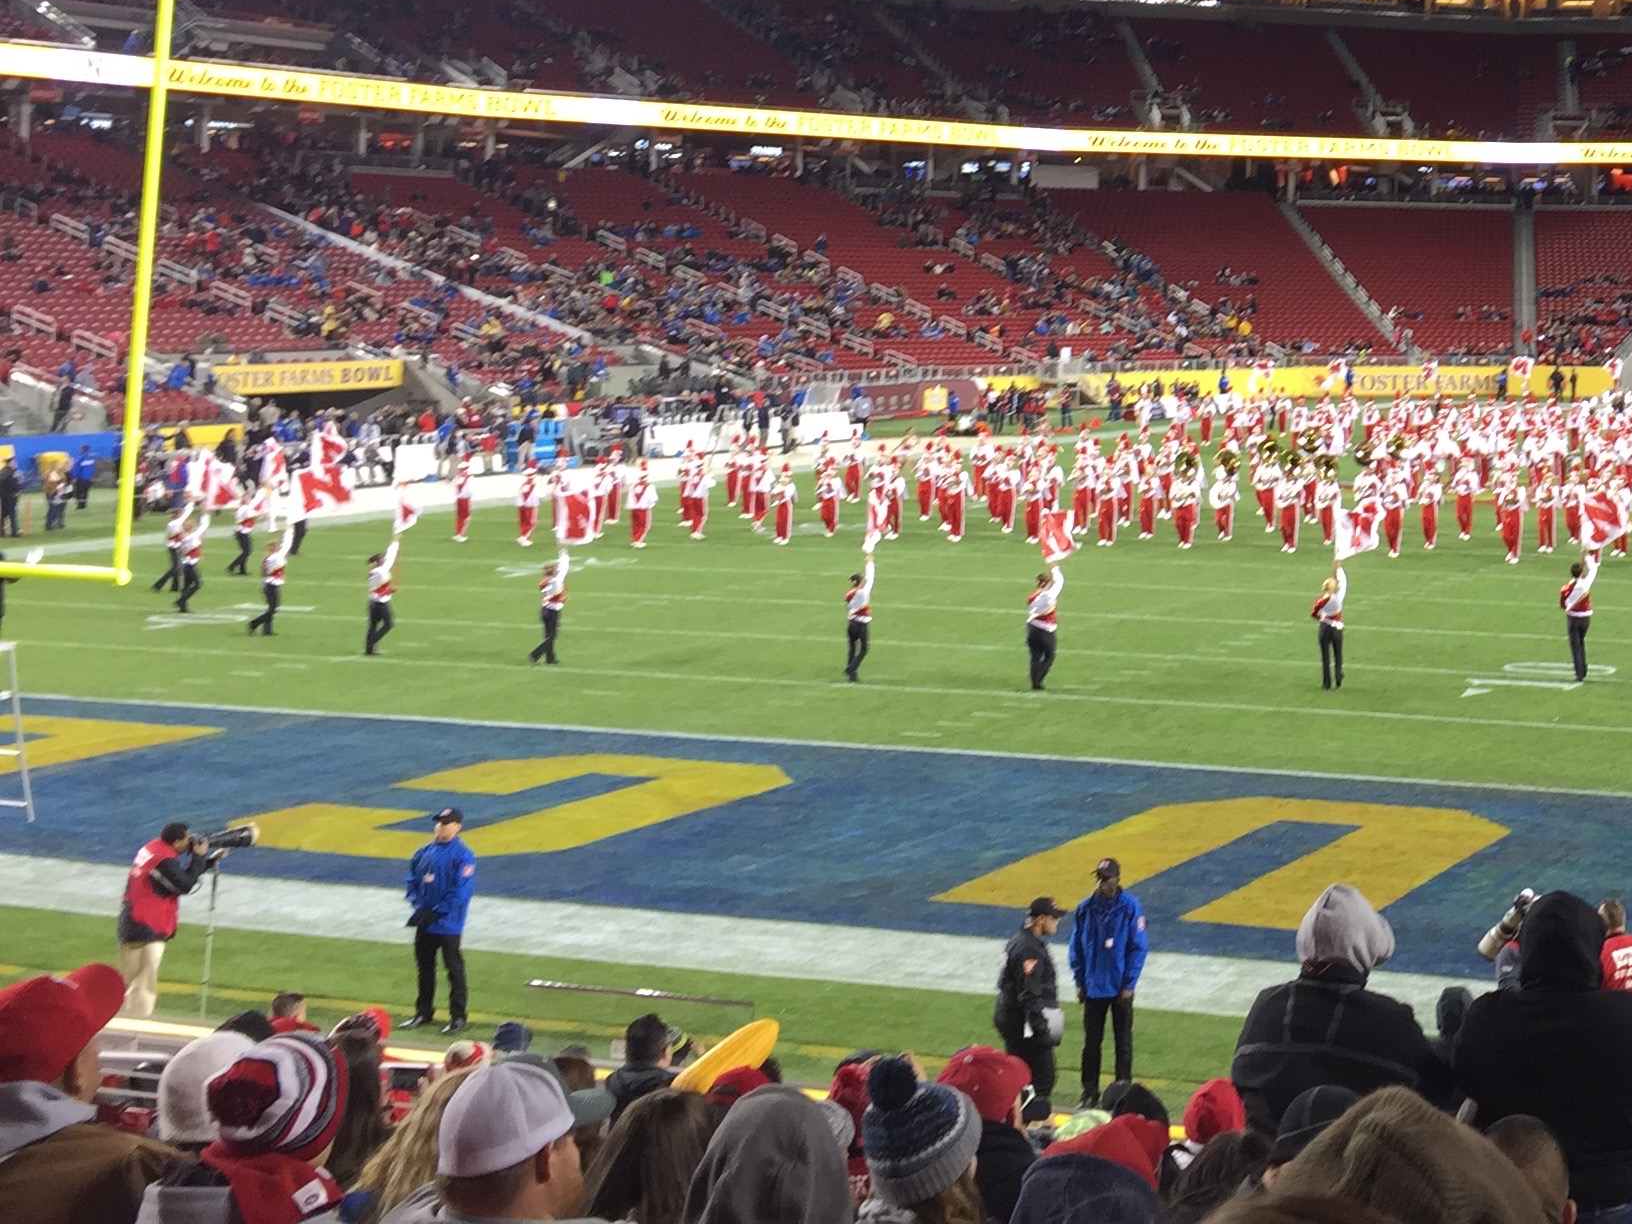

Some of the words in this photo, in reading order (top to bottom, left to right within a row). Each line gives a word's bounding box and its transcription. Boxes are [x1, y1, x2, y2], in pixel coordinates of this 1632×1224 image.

[168, 67, 251, 90] Welcome
[661, 108, 738, 128] Welcome
[1088, 134, 1169, 151] Welcome
[219, 370, 275, 389] OSTER
[279, 368, 336, 386] FARMS
[340, 365, 394, 384] BOWL
